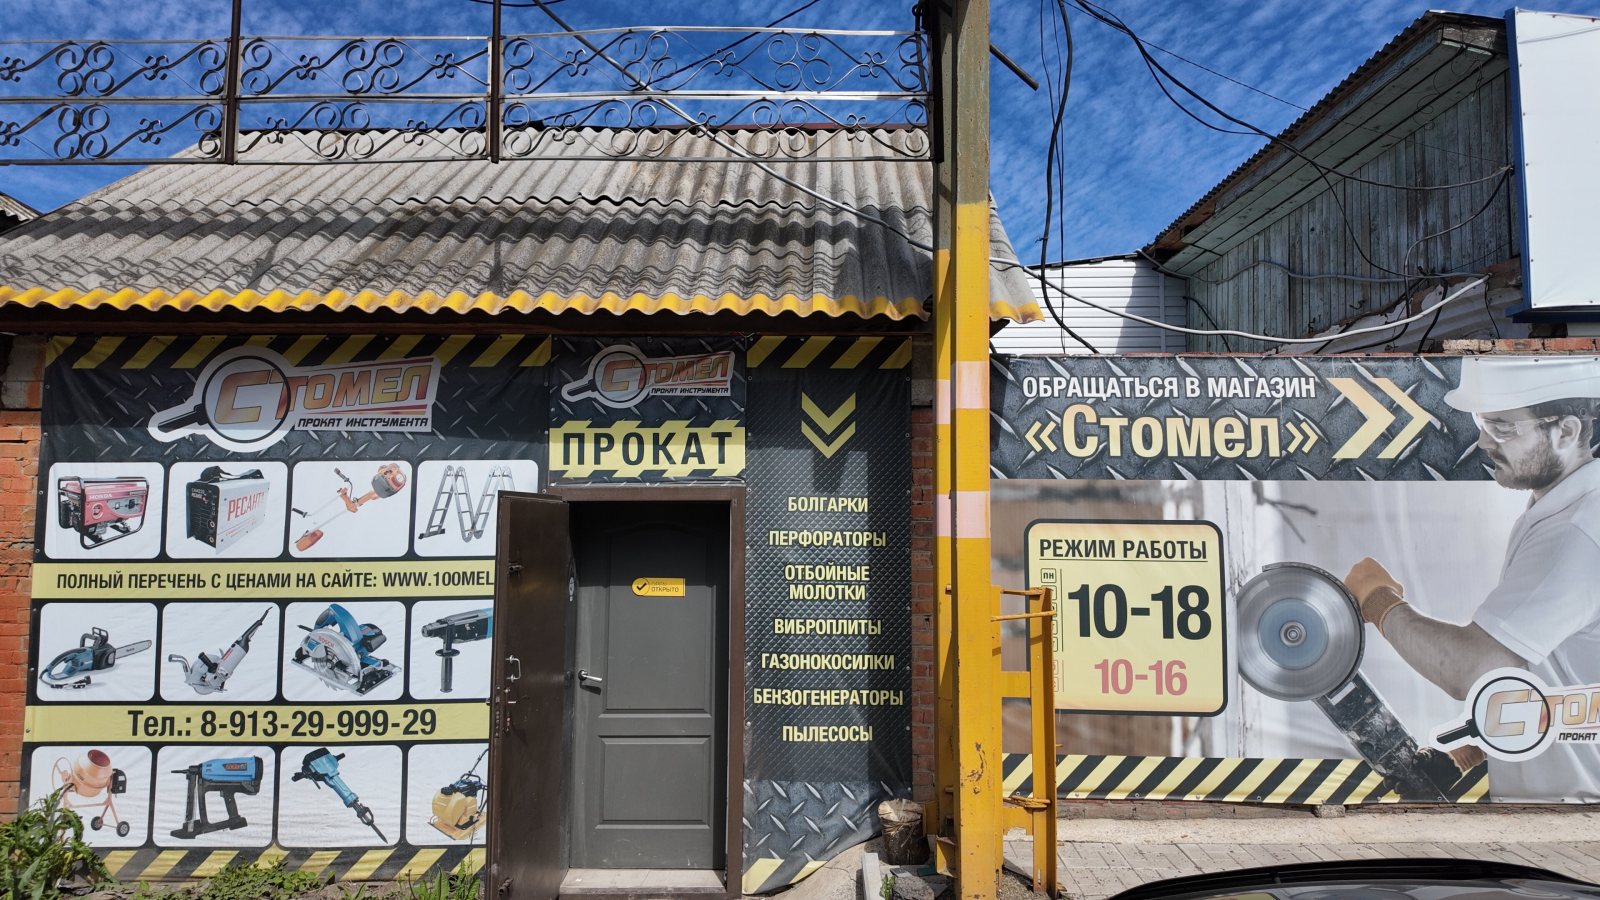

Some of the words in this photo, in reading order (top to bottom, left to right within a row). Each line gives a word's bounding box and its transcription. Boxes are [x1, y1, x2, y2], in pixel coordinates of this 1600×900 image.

[1022, 376, 1179, 401] ОБРАЩАТЬСЯ
[1186, 377, 1201, 398] В
[1208, 377, 1316, 398] МАГАЗИН
[297, 417, 343, 428] ПРОКАТ
[345, 417, 429, 428] ИНСТРУМЕНТА
[561, 431, 733, 466] ПРОКАТ
[787, 496, 869, 513] БОЛГАРКИ
[769, 530, 887, 547] ПЕРФОРАТОРЫ
[1039, 539, 1116, 558] РЕЖИМ
[1122, 540, 1207, 560] РАБОТЫ
[57, 570, 123, 589] ПОЛНЫЙ
[128, 573, 206, 589] ПЕРЕЧЕНЬ
[211, 573, 221, 588] С
[226, 573, 291, 591] ЦЕНАМИ
[296, 573, 316, 588] НА
[321, 569, 377, 588] САЙТЕ:
[784, 561, 870, 581] ОТБОЙНЫЕ
[789, 584, 866, 600] МОЛОТКИ
[1067, 583, 1212, 640] 10-18
[774, 619, 882, 635] ВИБРОПЛИТЫ
[761, 653, 895, 670] ГАЗОНОКОСИЛКИ
[1094, 658, 1188, 696] 10-16
[753, 688, 904, 706] БЕНЗОГЕНЕРАТОРЫ
[128, 709, 191, 737] Тел.:
[200, 708, 437, 738] 8-913-29-999-29
[782, 726, 873, 742] ПЫЛЕСОСЫ
[1559, 732, 1598, 741] ПРОКАТ
